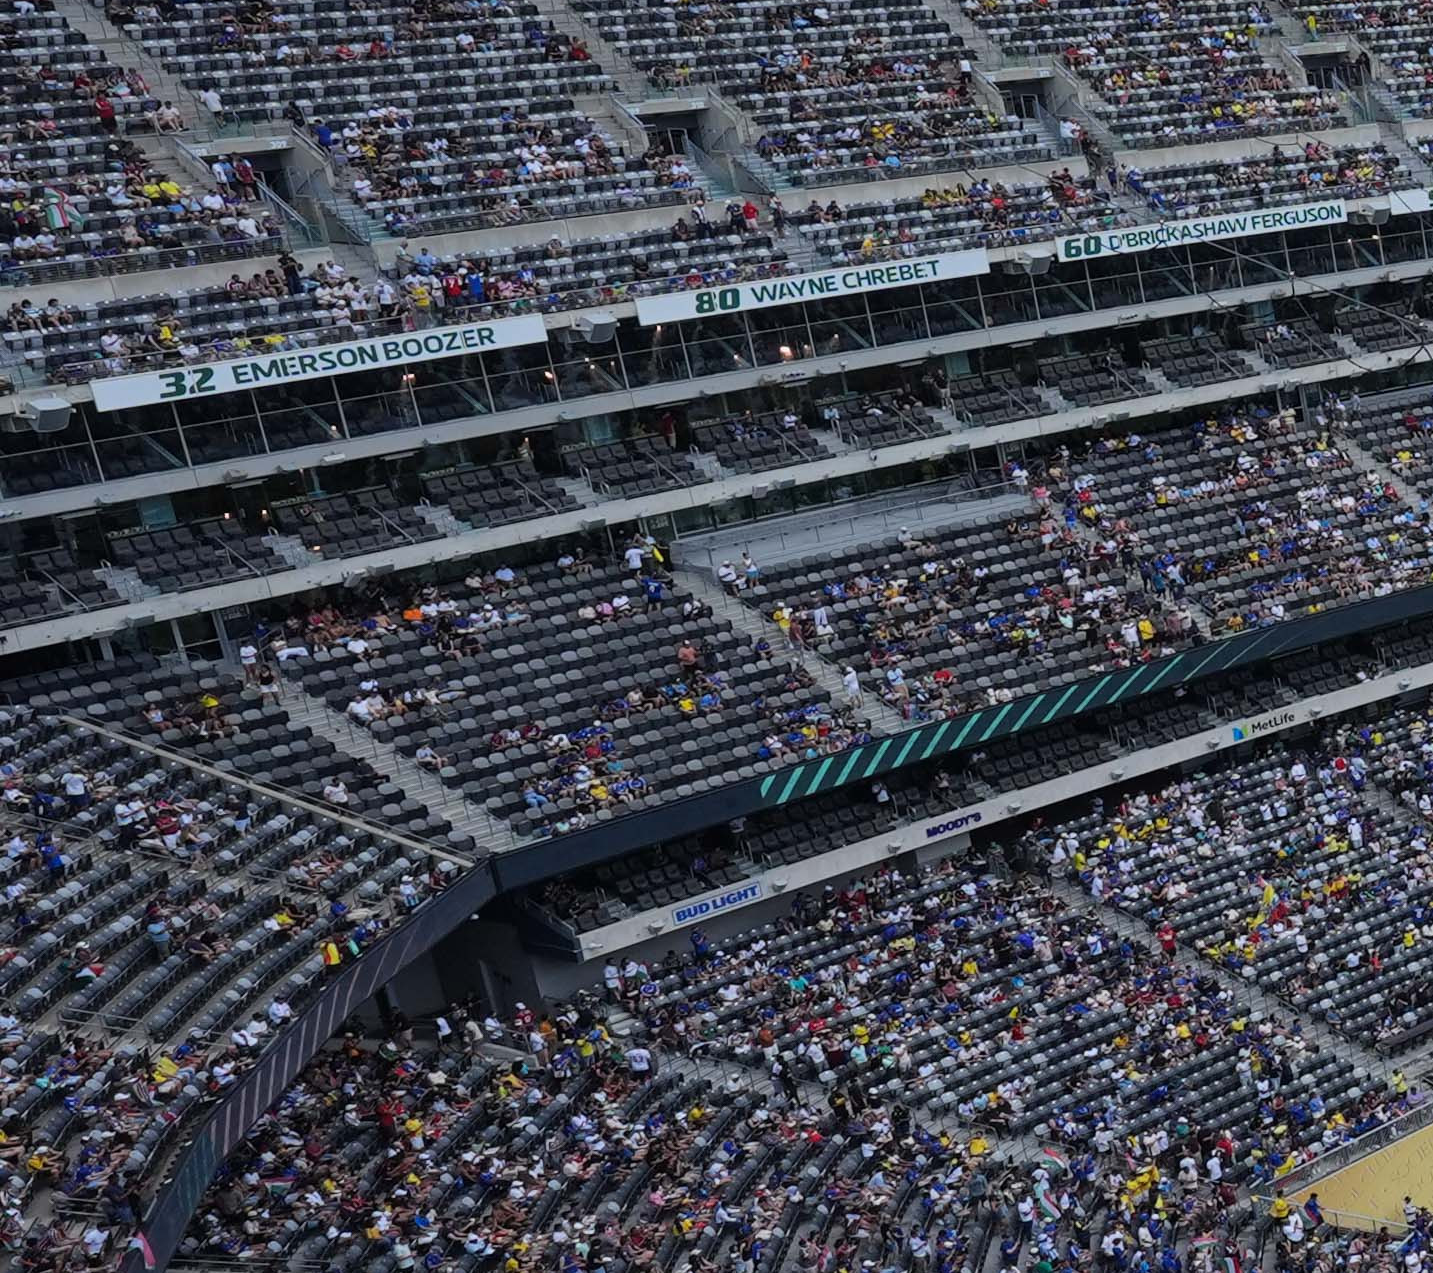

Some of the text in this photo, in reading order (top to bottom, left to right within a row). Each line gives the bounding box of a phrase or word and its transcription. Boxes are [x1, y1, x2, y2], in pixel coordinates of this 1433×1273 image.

[1063, 206, 1342, 258] 60 D'BRICKASHAW FERGUSON
[695, 260, 942, 314] 80 WAYNE CHREBET
[159, 327, 498, 399] 32 EMERSON BOOZER
[1252, 713, 1295, 733] MetLife
[926, 812, 982, 838] MOODY'S
[675, 885, 759, 922] BUD LIGHT
